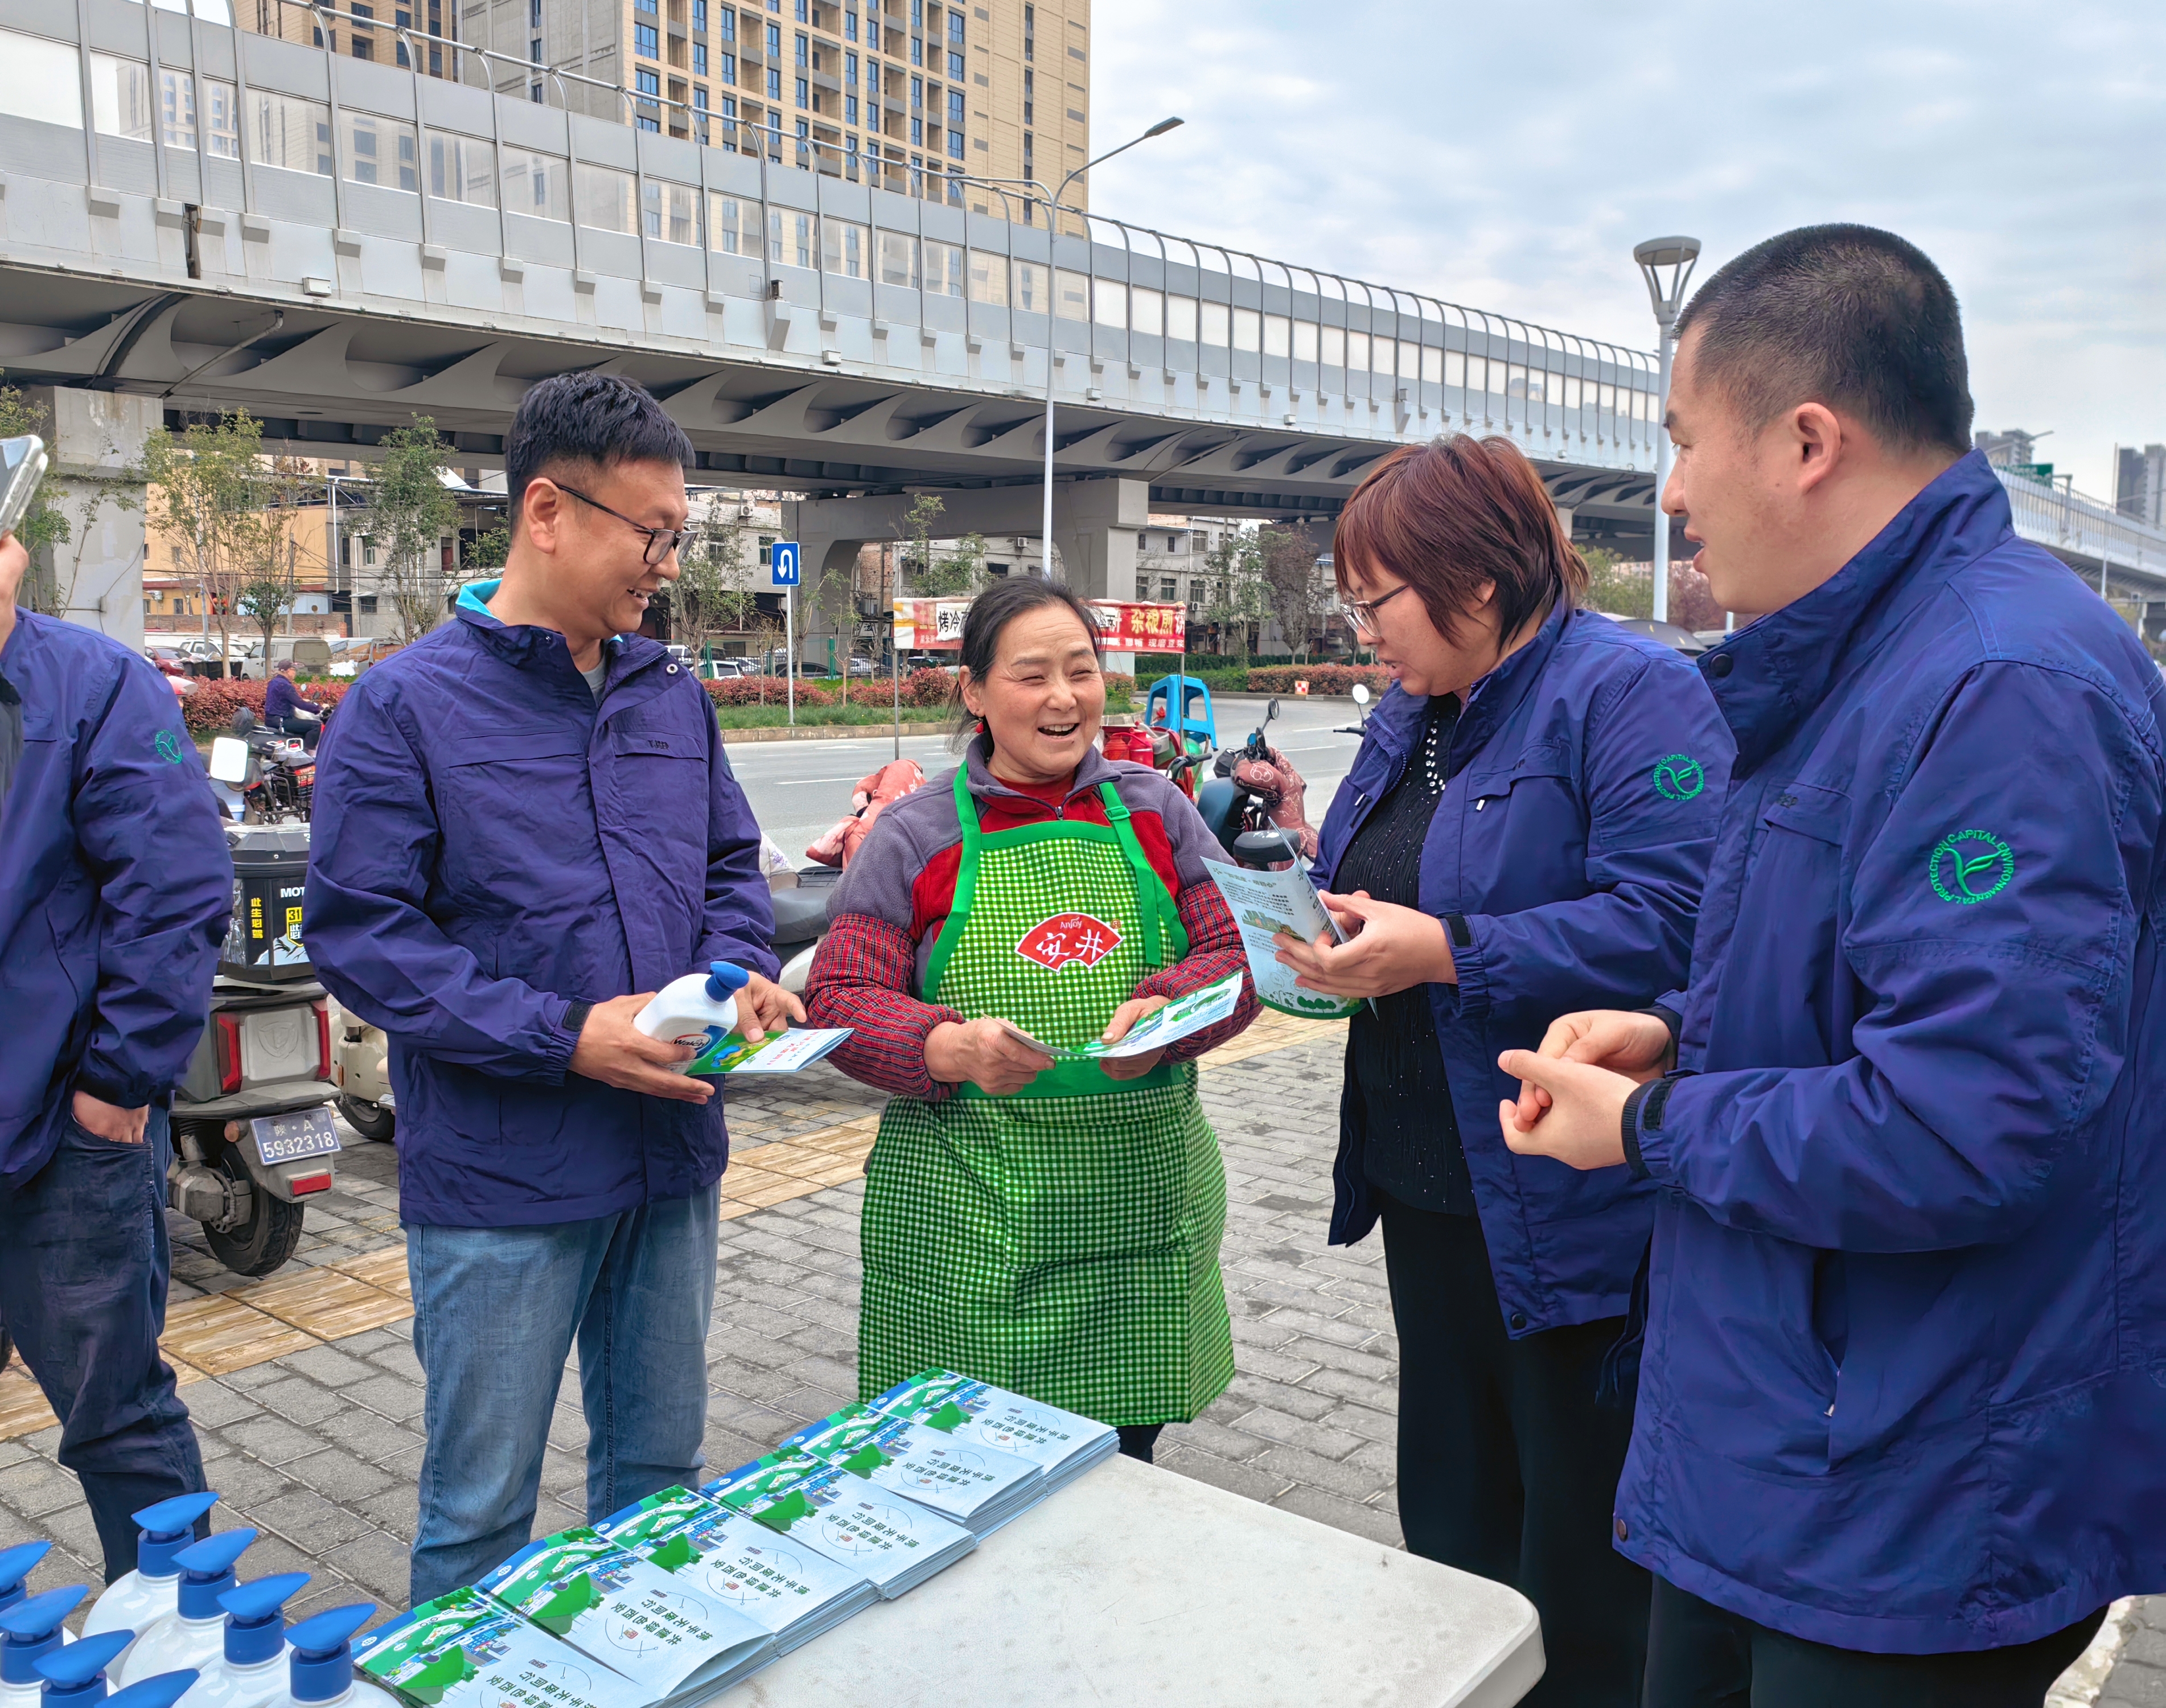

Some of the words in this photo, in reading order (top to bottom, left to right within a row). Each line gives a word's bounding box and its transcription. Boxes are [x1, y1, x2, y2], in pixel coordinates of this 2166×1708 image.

[938, 610, 969, 633] 烤冷
[1947, 830, 1997, 846] CAPITAL
[1929, 840, 1955, 902] PROTECTION
[1955, 841, 2015, 905] ENVIRONMENTAL
[250, 897, 263, 939] 此生必驾
[289, 909, 302, 921] 31
[1036, 929, 1105, 964] 安井
[262, 1131, 335, 1159] 5932318
